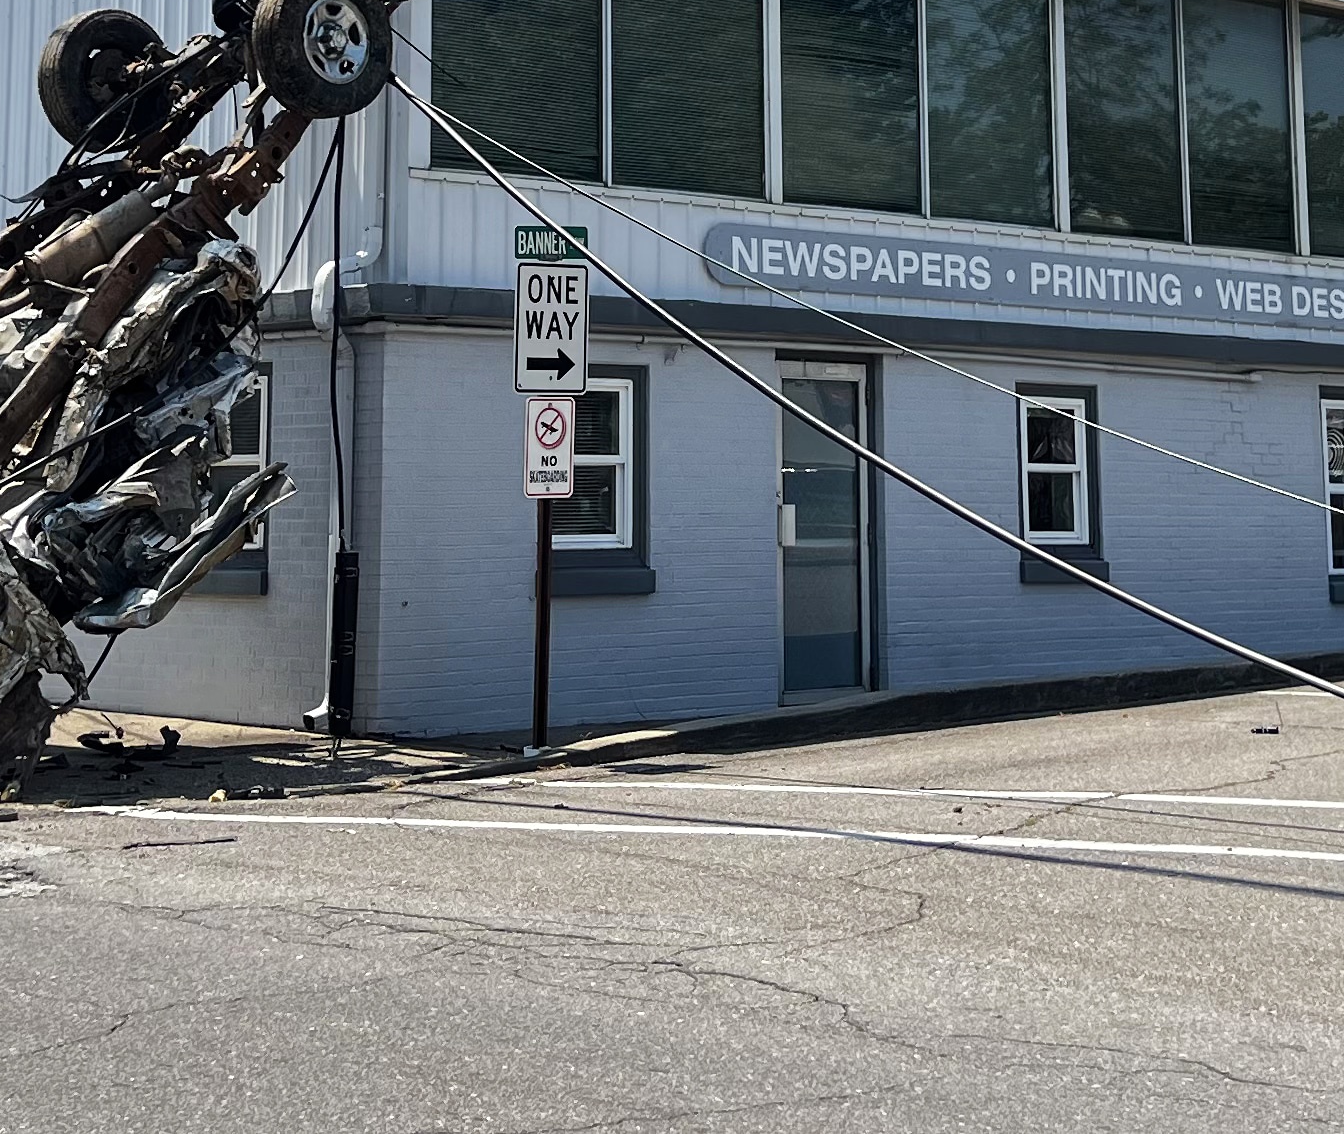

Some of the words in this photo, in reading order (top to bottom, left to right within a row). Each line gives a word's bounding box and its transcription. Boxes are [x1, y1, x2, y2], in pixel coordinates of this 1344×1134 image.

[518, 231, 567, 255] BANNER
[528, 274, 579, 304] ONE
[731, 236, 992, 291] NEWSPAPERS
[1030, 261, 1182, 307] PRINTING
[1215, 278, 1282, 314] WEB
[526, 310, 579, 340] WAY
[541, 456, 558, 467] NO
